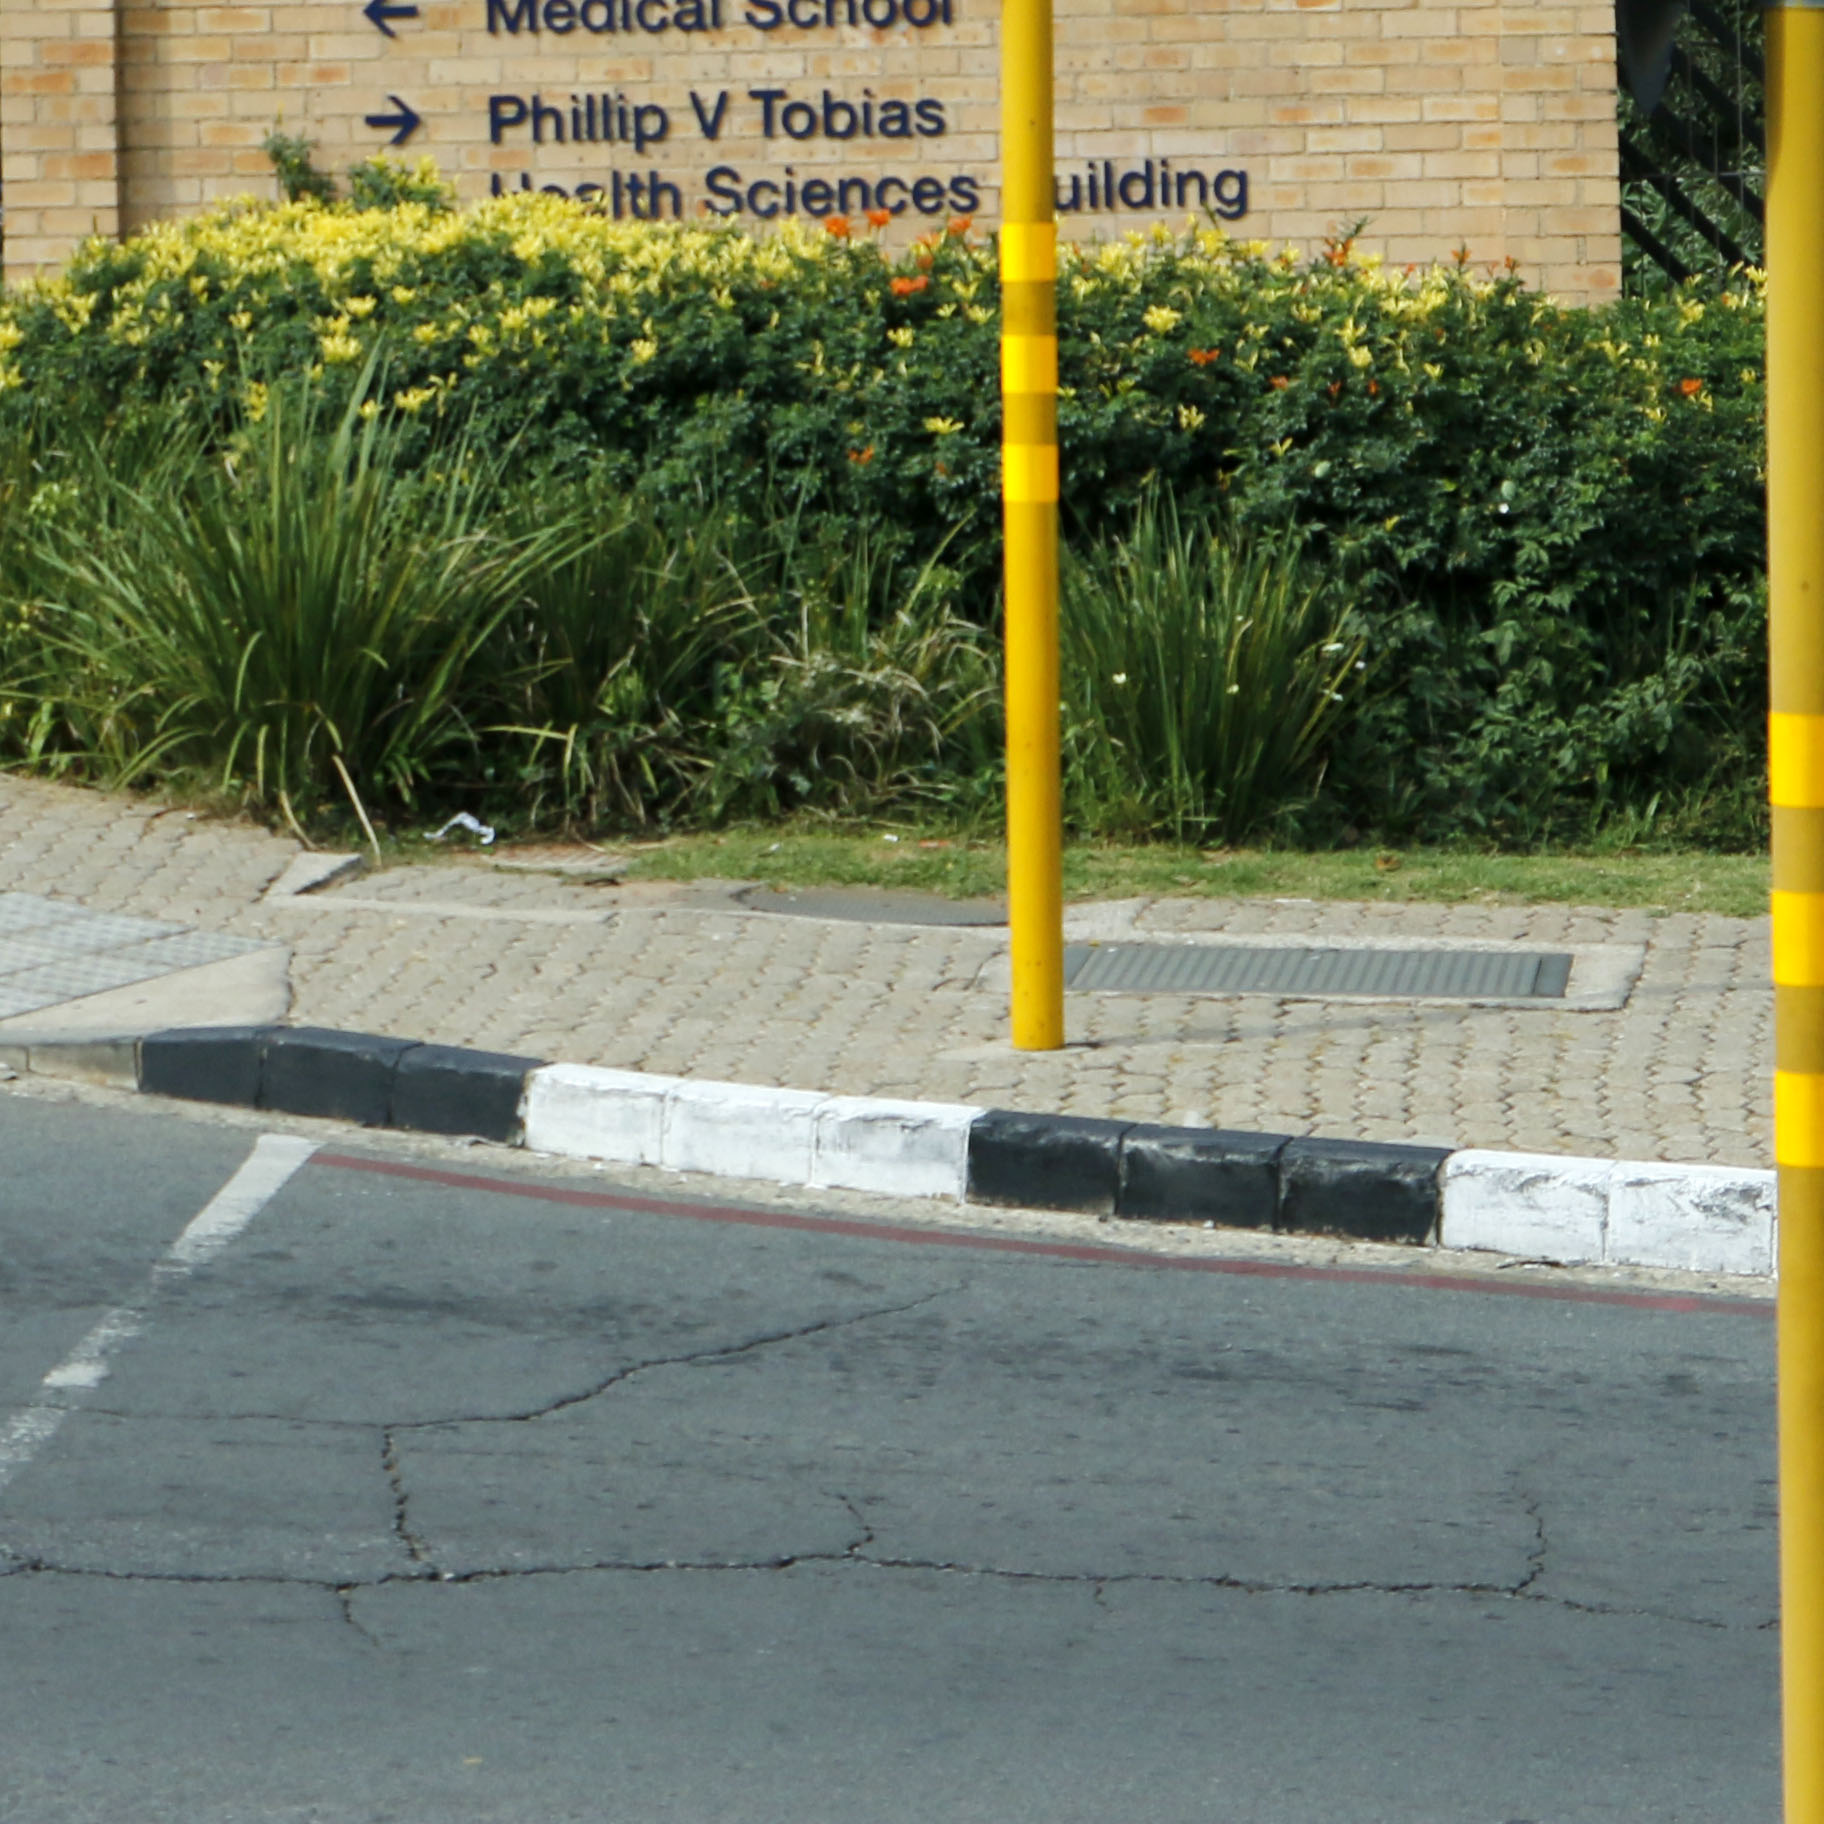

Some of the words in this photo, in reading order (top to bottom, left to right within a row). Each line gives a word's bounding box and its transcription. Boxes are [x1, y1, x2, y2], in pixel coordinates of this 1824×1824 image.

[489, 91, 671, 154] Phillip
[689, 88, 729, 141] V
[748, 87, 946, 140] Tobias
[703, 164, 980, 219] Sciences
[1053, 158, 1250, 221] uilding
